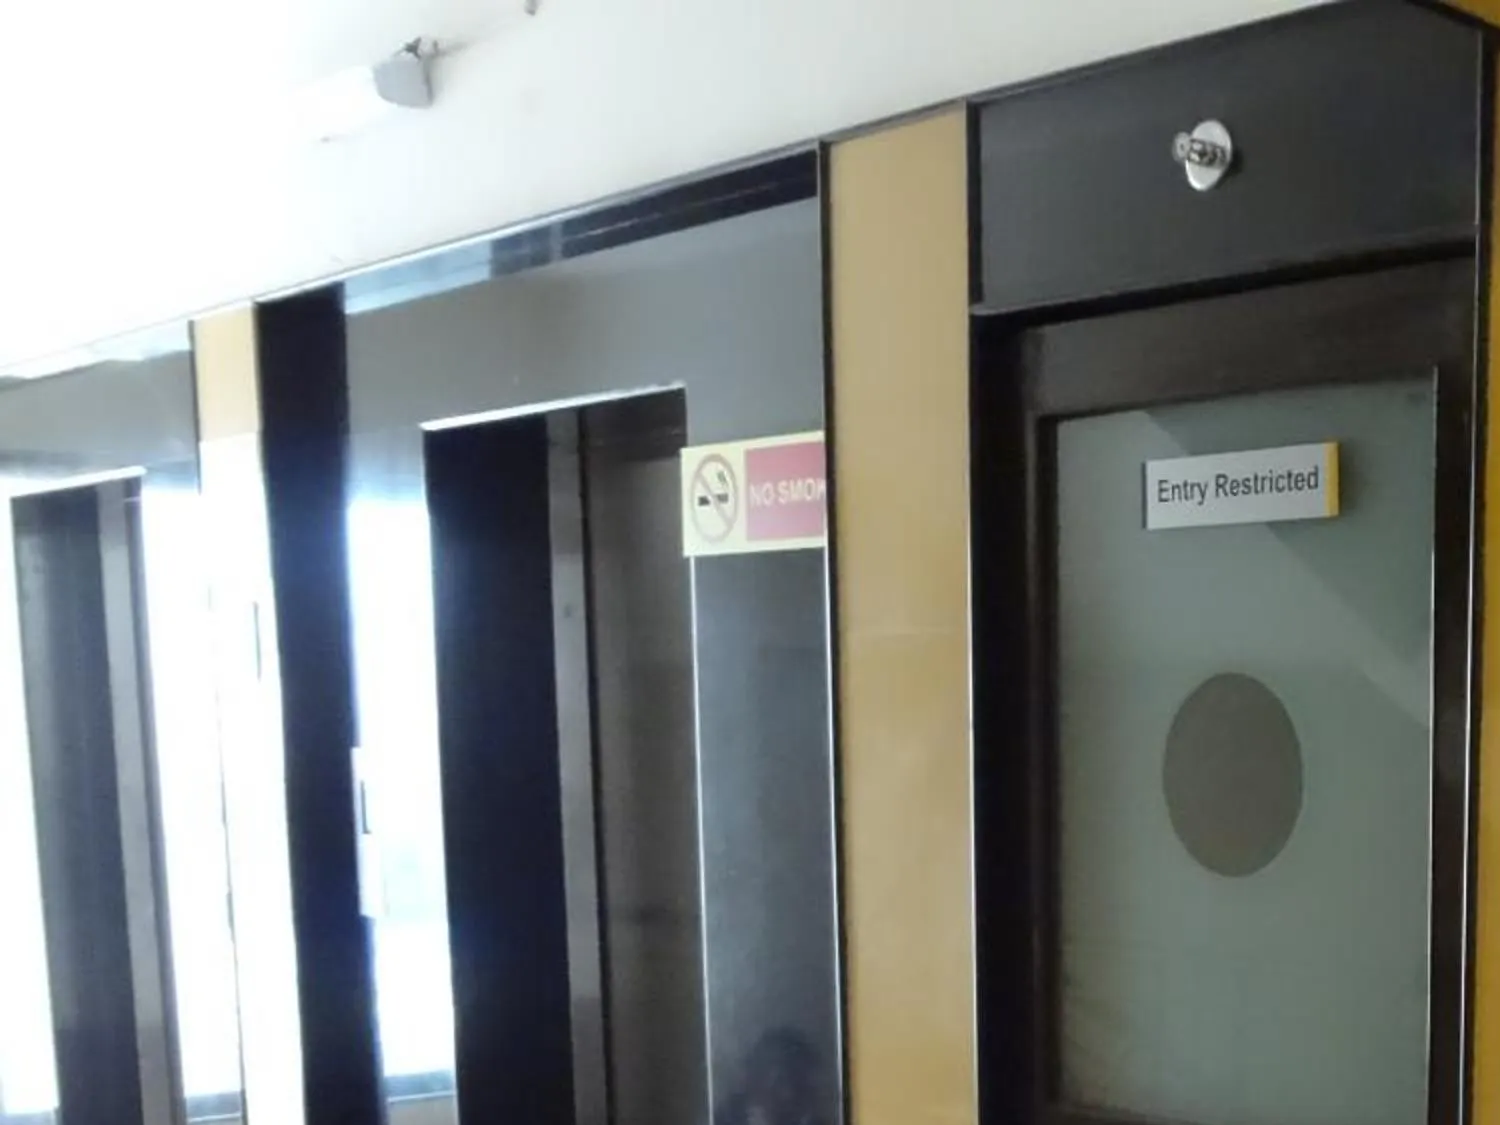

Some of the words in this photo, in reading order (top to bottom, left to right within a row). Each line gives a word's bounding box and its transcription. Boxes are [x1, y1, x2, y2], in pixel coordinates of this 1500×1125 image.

[750, 482, 775, 507] NO
[1157, 478, 1209, 506] Entry
[1214, 465, 1319, 498] Restricted
